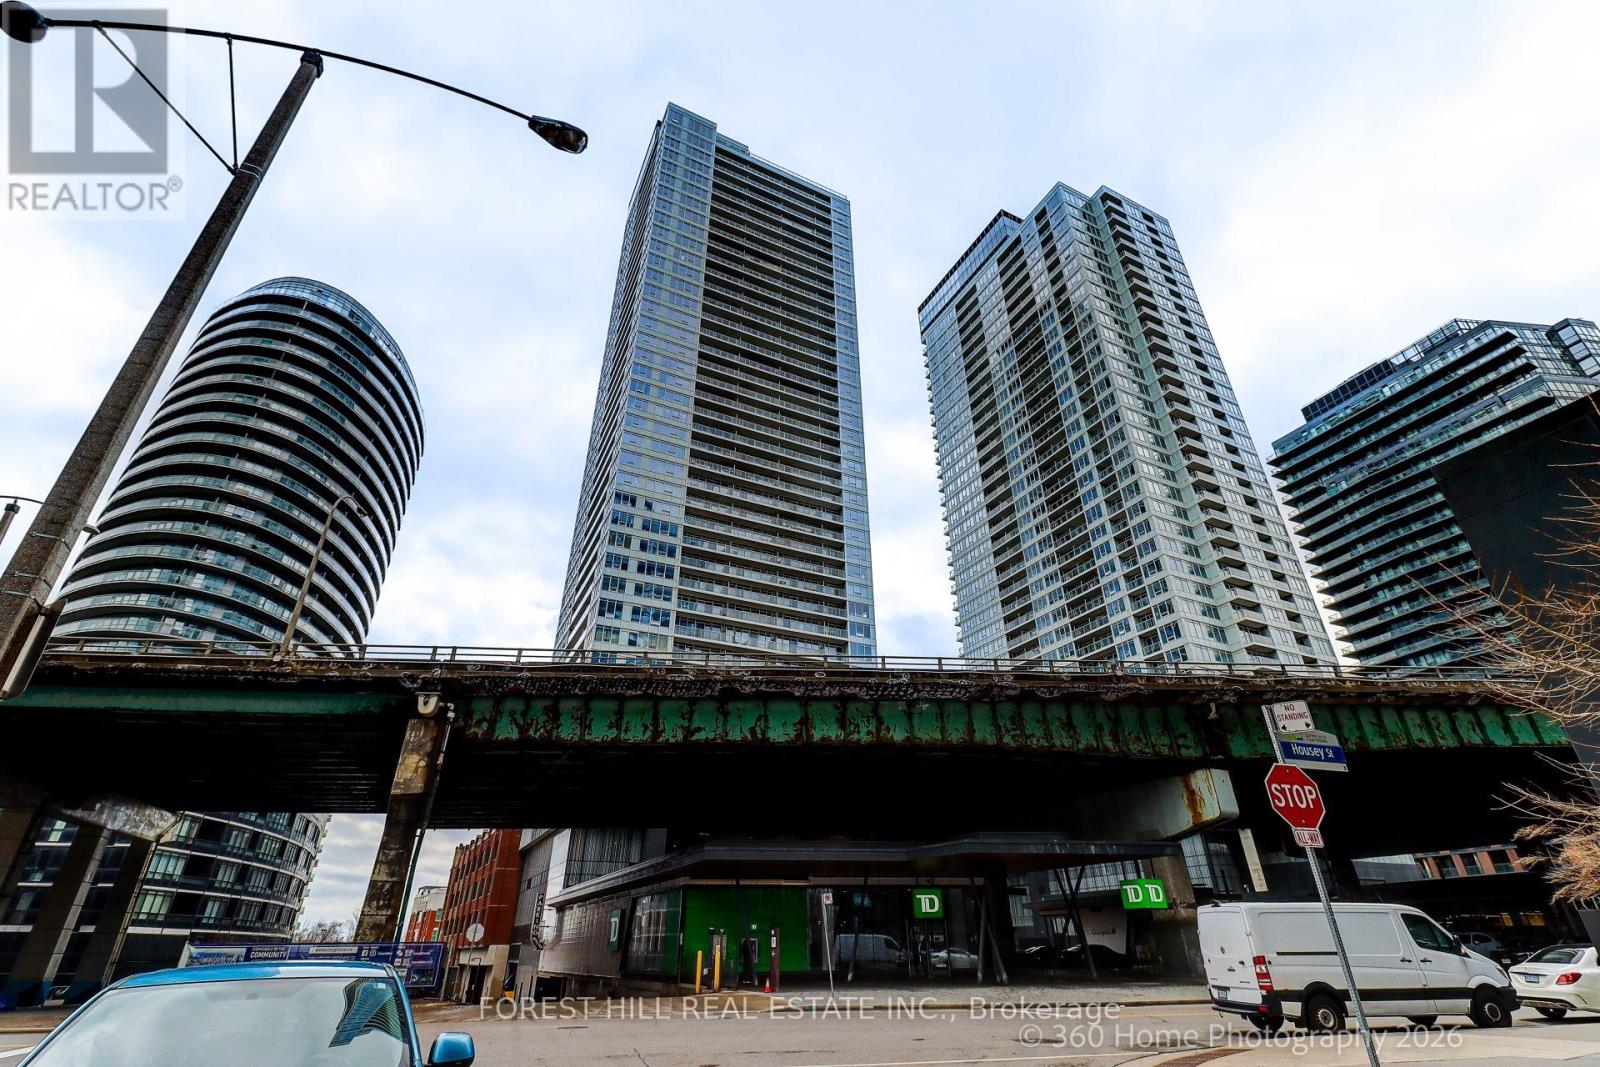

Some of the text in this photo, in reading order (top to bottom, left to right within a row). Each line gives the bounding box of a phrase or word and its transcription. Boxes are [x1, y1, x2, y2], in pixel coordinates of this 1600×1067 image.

[1283, 703, 1295, 712] NO
[1276, 711, 1309, 722] STANDING
[1291, 743, 1335, 760] Housey St
[1271, 783, 1317, 809] STOP
[1122, 884, 1164, 903] TD TD
[915, 894, 940, 913] TD
[250, 951, 288, 959] COMMUNITY
